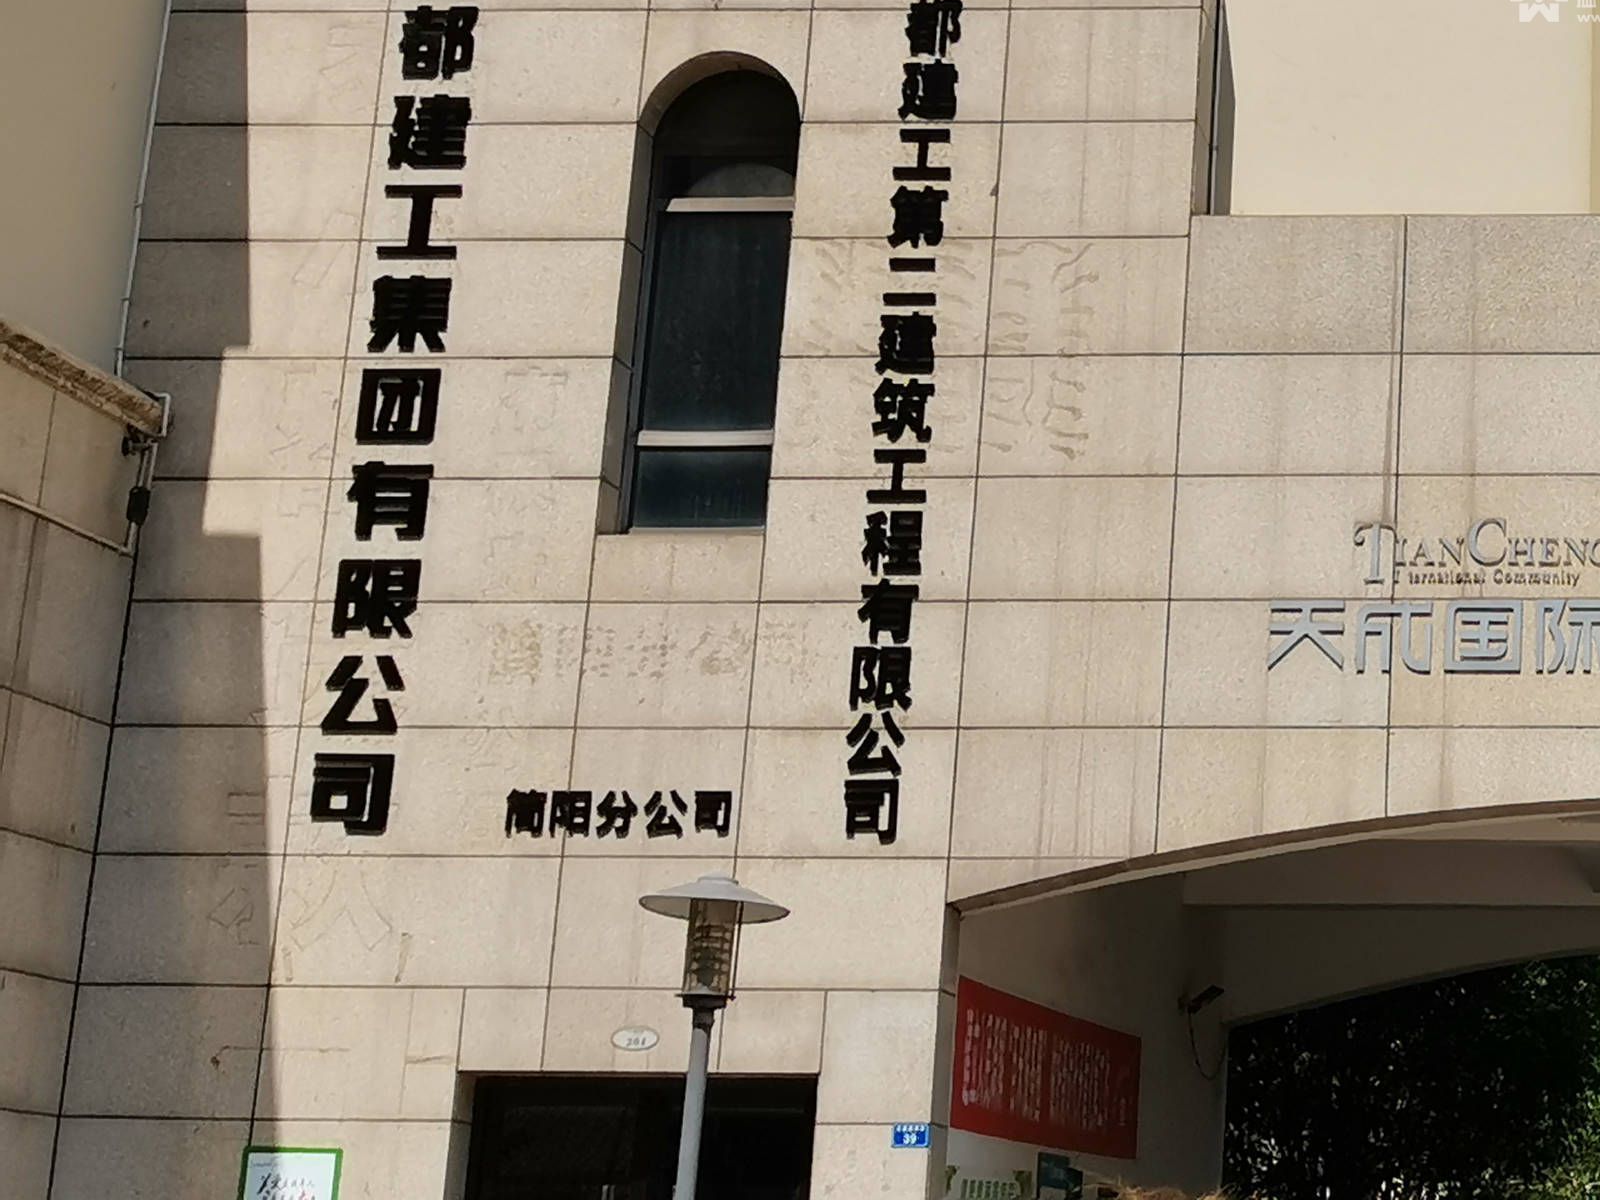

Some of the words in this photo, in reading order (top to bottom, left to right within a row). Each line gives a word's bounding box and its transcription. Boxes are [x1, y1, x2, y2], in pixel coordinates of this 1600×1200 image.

[1493, 569, 1580, 588] Community
[505, 789, 732, 839] 简阳分公司
